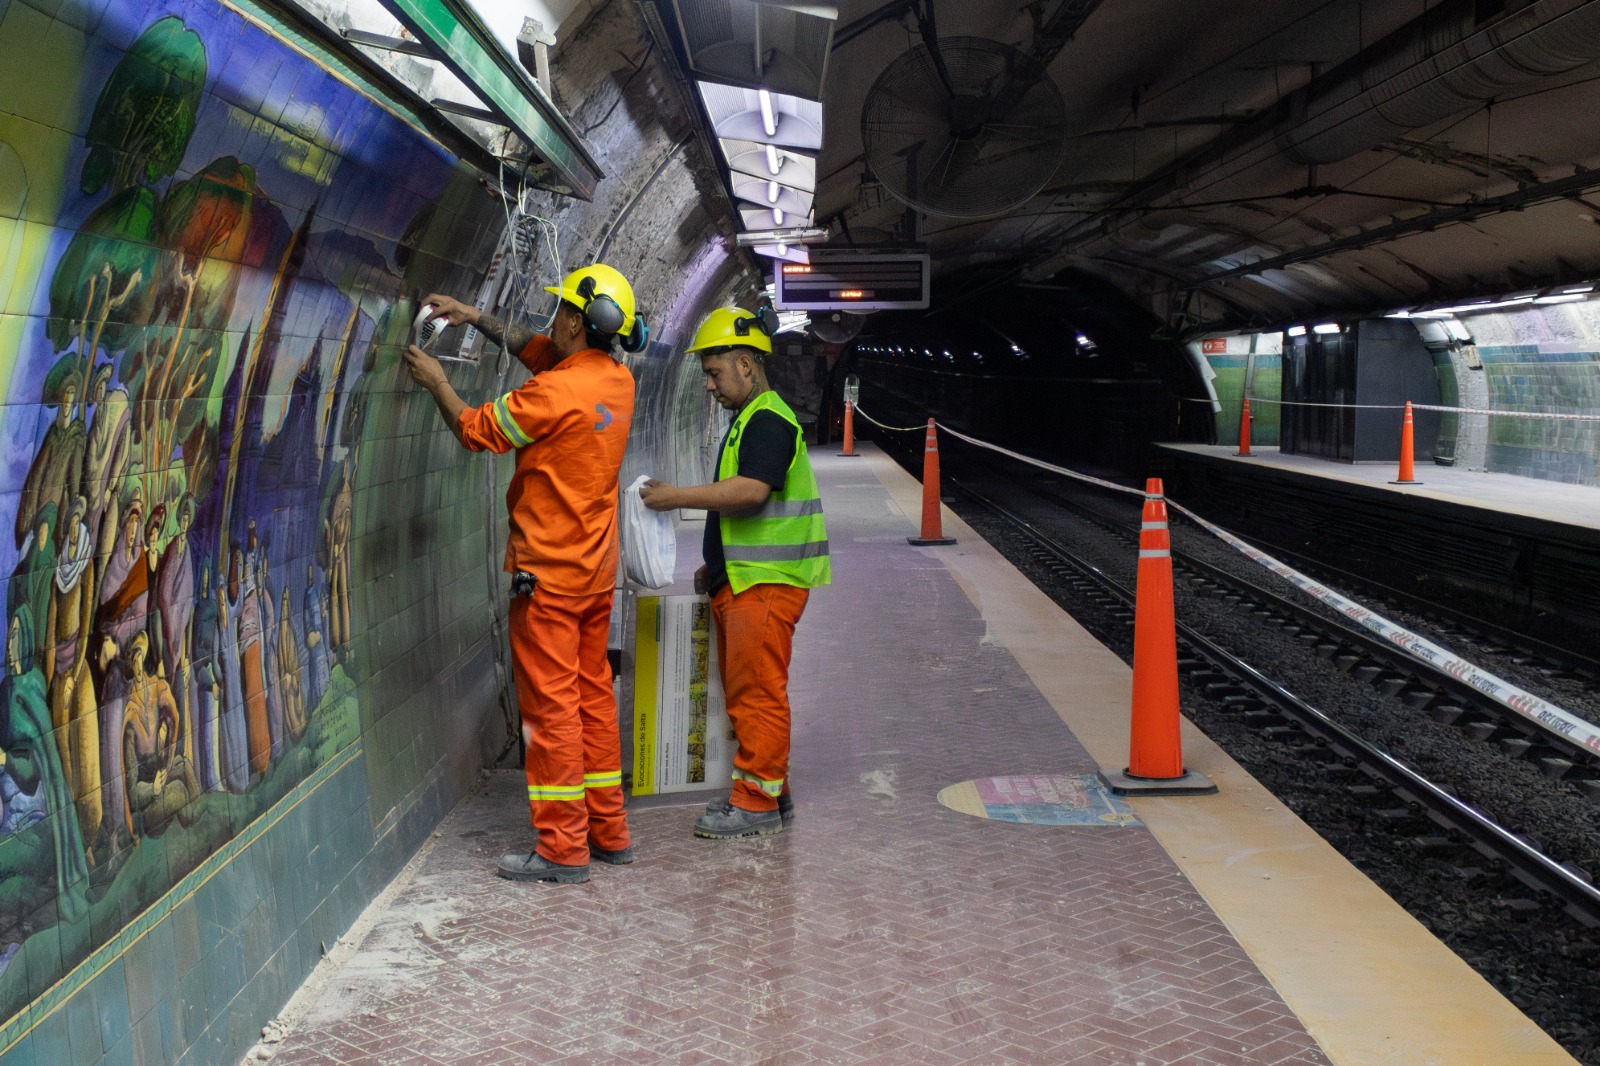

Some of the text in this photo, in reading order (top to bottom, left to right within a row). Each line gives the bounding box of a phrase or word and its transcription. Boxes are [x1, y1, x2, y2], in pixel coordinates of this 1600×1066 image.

[638, 713, 647, 787] Evocaciones de Salta
